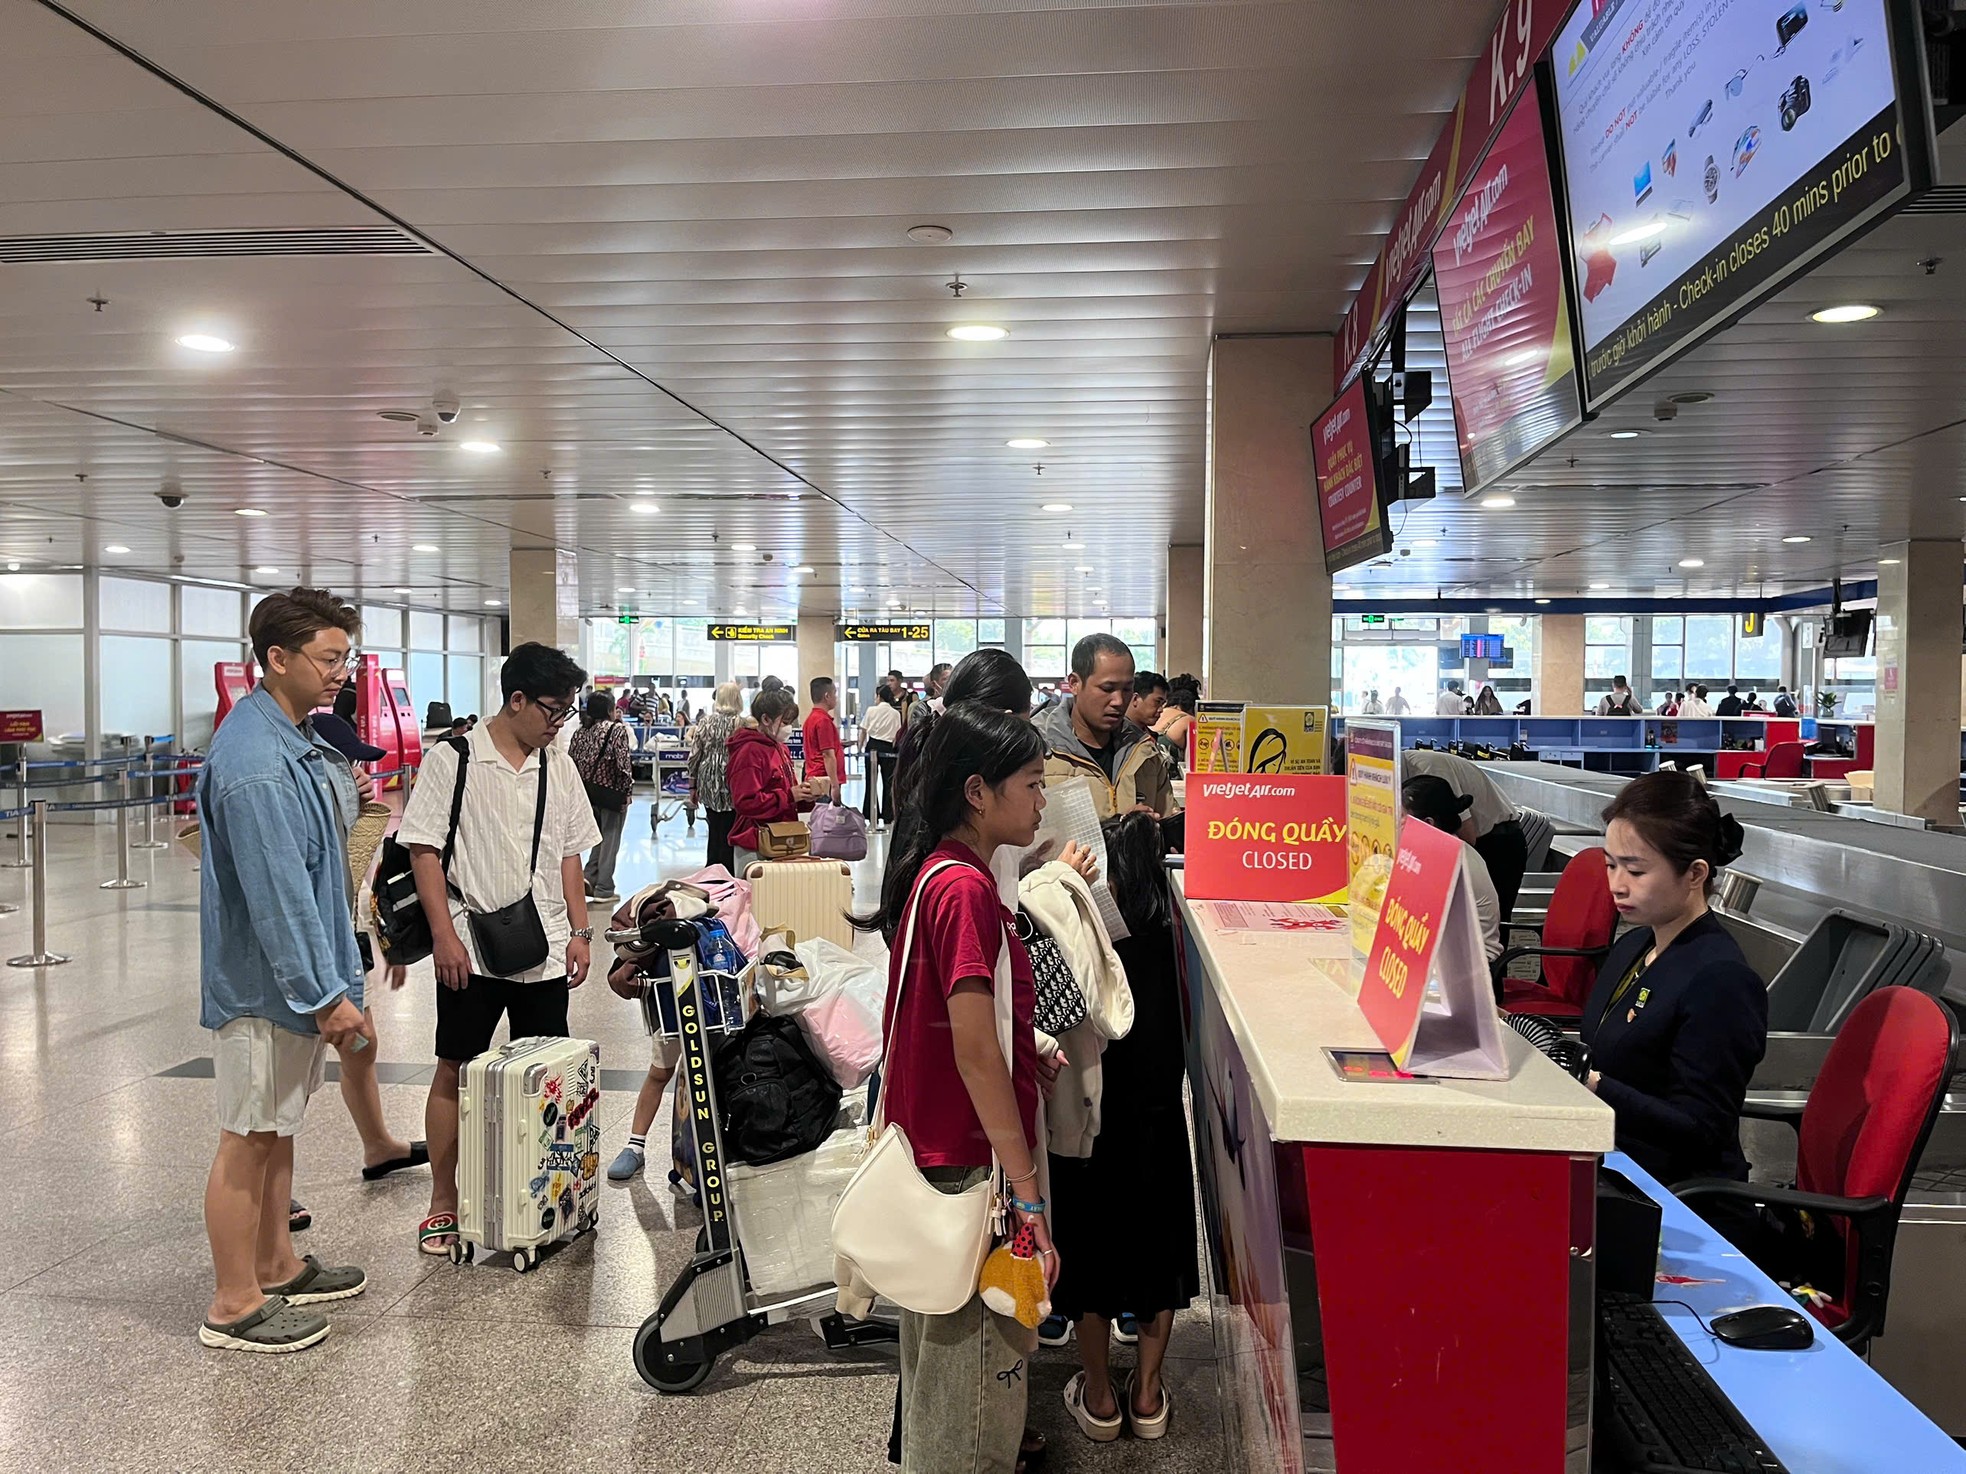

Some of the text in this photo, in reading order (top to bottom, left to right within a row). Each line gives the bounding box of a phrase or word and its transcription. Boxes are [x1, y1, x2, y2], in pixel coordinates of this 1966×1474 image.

[1622, 19, 1644, 54] KHÔNG
[1605, 124, 1614, 139] DO
[1614, 106, 1627, 128] NOT
[1625, 109, 1638, 132] NOT
[1516, 215, 1535, 257] BAY
[1627, 314, 1647, 350] khởi
[1648, 299, 1672, 336] hành
[1679, 259, 1728, 310] Check-in
[1729, 225, 1770, 273] closes
[1772, 205, 1790, 238] 40
[1792, 179, 1829, 225] mins
[1831, 146, 1869, 203] prior
[1872, 131, 1892, 164] to
[1495, 263, 1533, 320] CHECK-IN
[901, 626, 929, 639] 1-25
[1744, 612, 1755, 633] J
[6, 810, 19, 818] TIA
[1207, 817, 1276, 843] ĐÓNG
[1282, 816, 1347, 845] QUẦY
[1242, 851, 1313, 870] CLOSED
[1385, 896, 1430, 956] ĐÓNG QUẦY
[1378, 945, 1409, 1000] CLOSED
[682, 1004, 724, 1222] GOLDSUN GROUP
